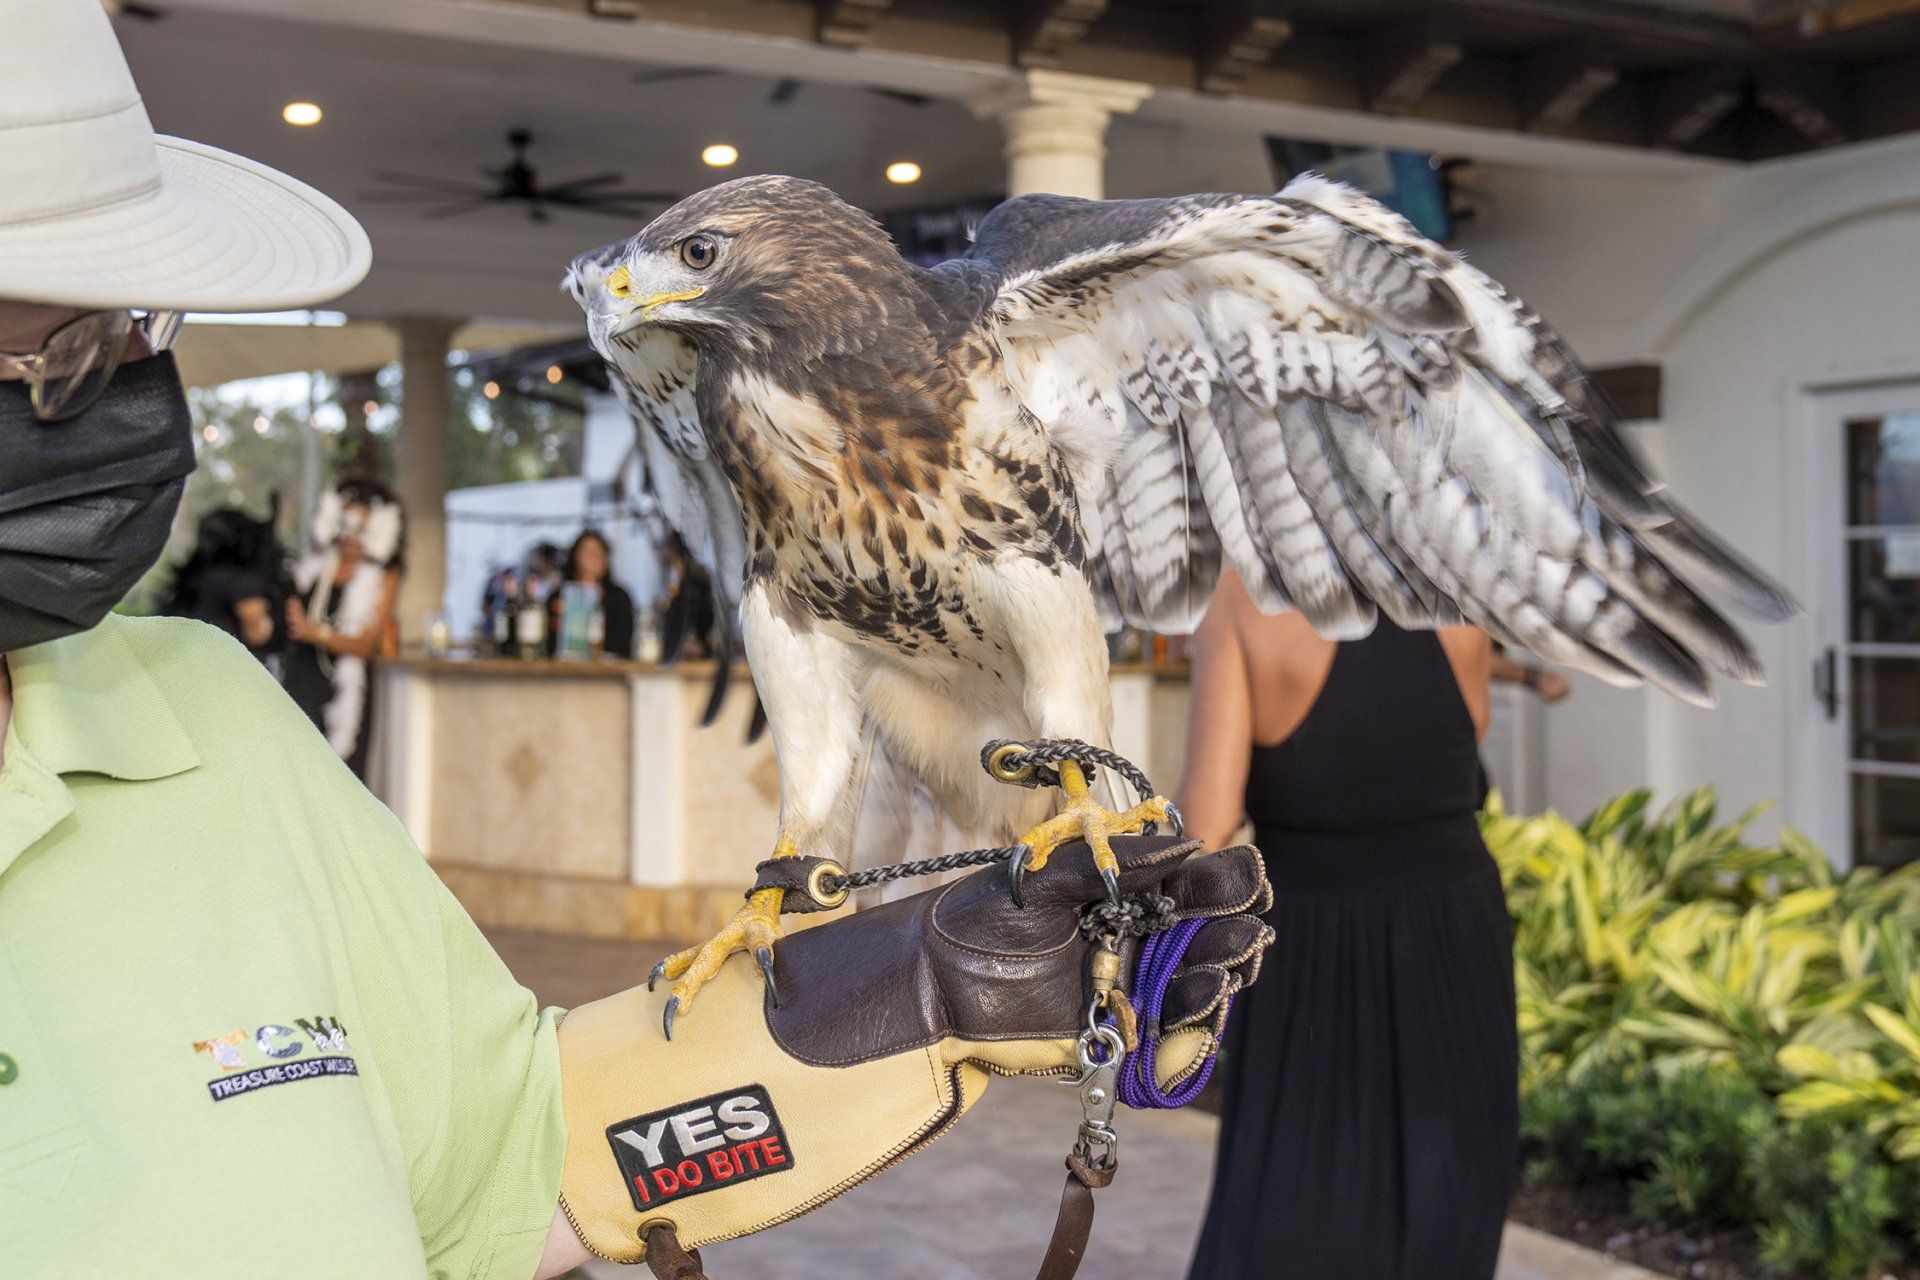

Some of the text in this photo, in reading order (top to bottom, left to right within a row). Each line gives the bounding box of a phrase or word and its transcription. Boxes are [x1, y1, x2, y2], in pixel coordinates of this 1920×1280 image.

[210, 1067, 286, 1098] TREASURE
[286, 1060, 323, 1080] COAST
[614, 1096, 770, 1168] YES
[634, 1136, 786, 1203] I DO BITE
